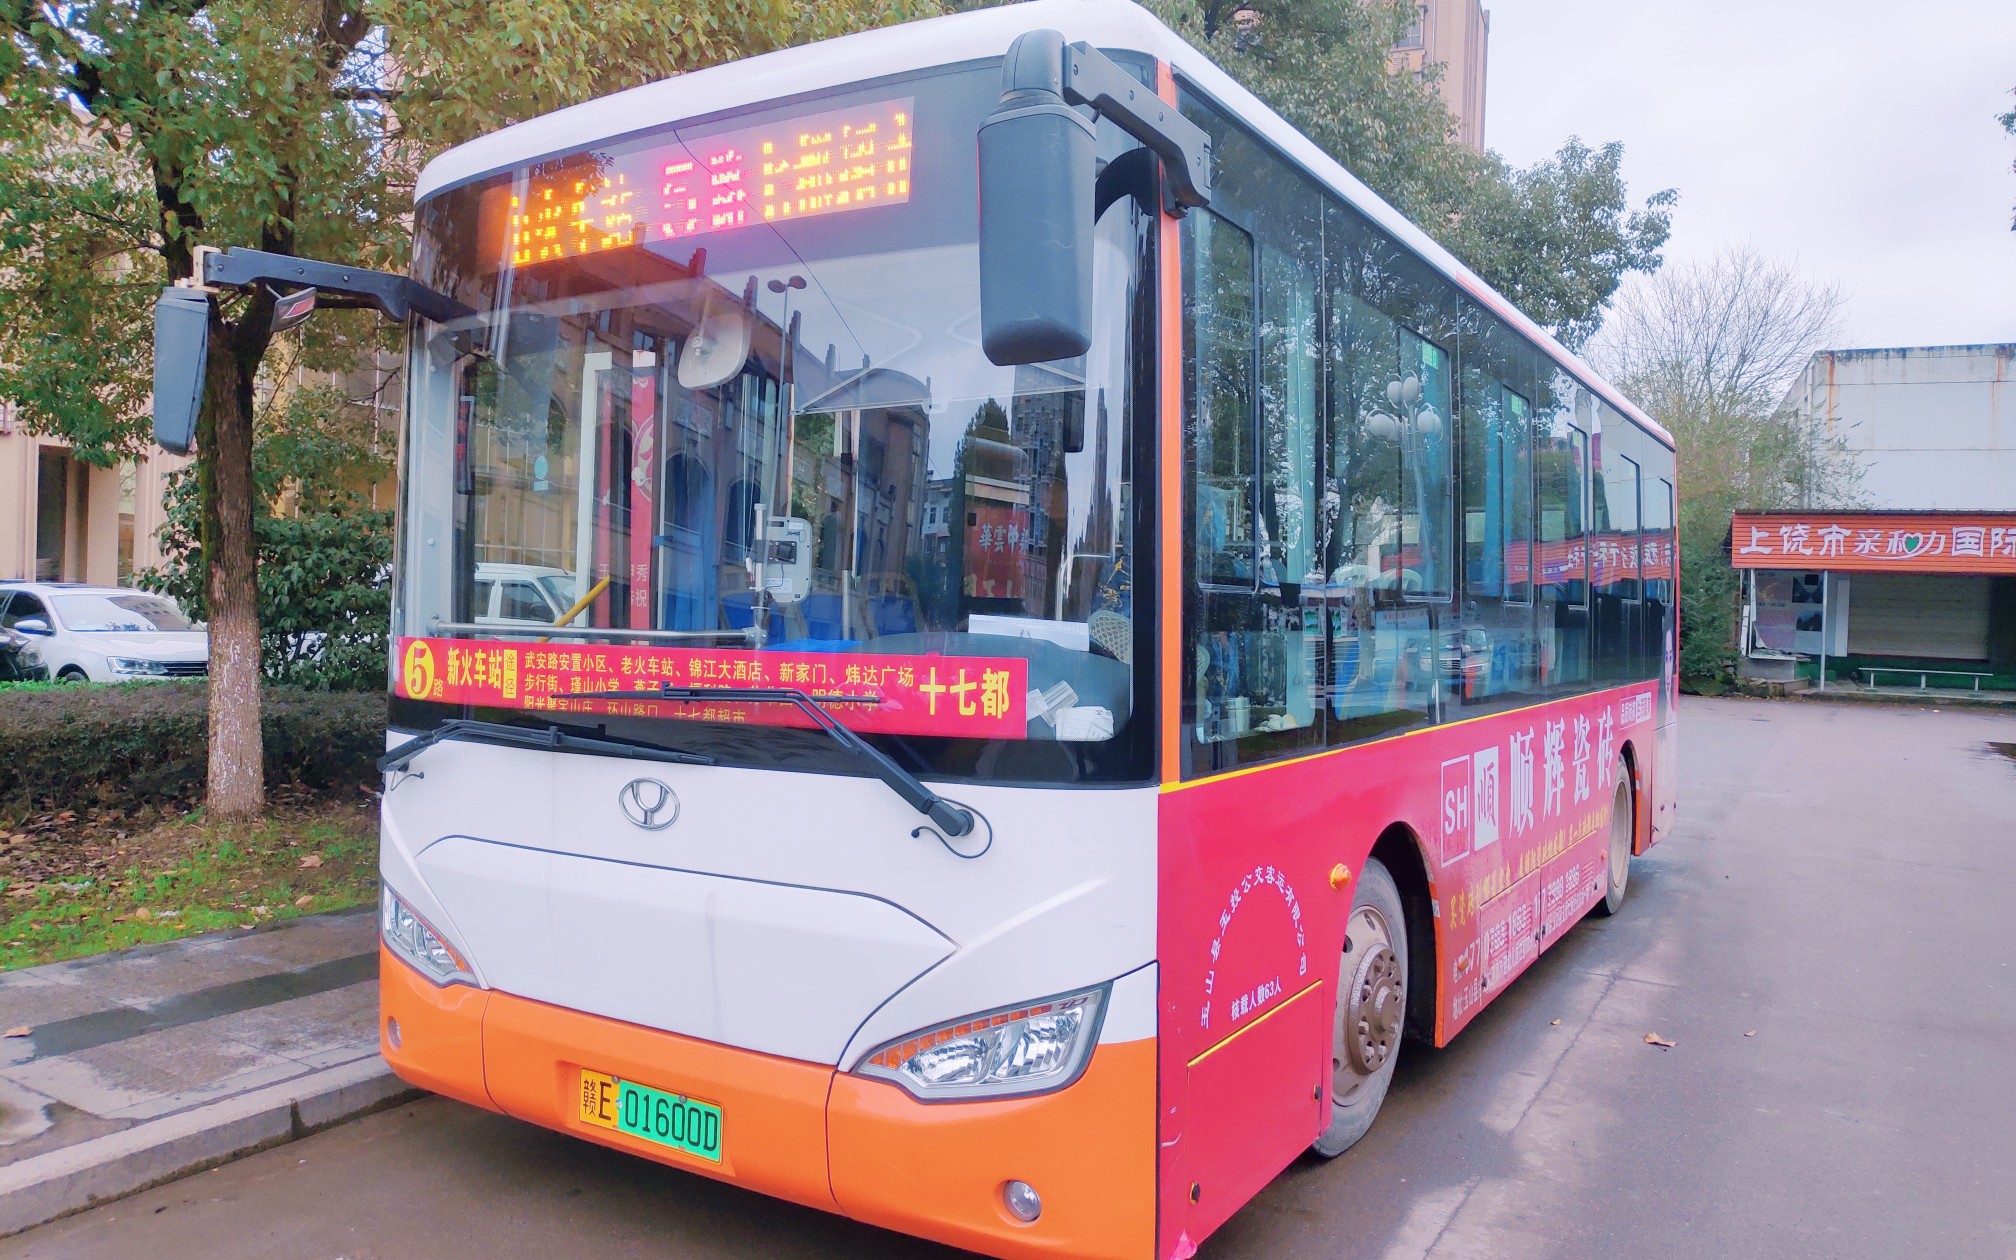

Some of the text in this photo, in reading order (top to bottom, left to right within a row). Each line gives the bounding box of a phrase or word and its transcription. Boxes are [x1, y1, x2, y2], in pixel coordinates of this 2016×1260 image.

[446, 646, 503, 689] 新火车站
[505, 653, 516, 695] 途径
[919, 666, 1010, 720] 十七都
[1508, 704, 1614, 840] 顺辉瓷砖
[1444, 785, 1469, 836] SH
